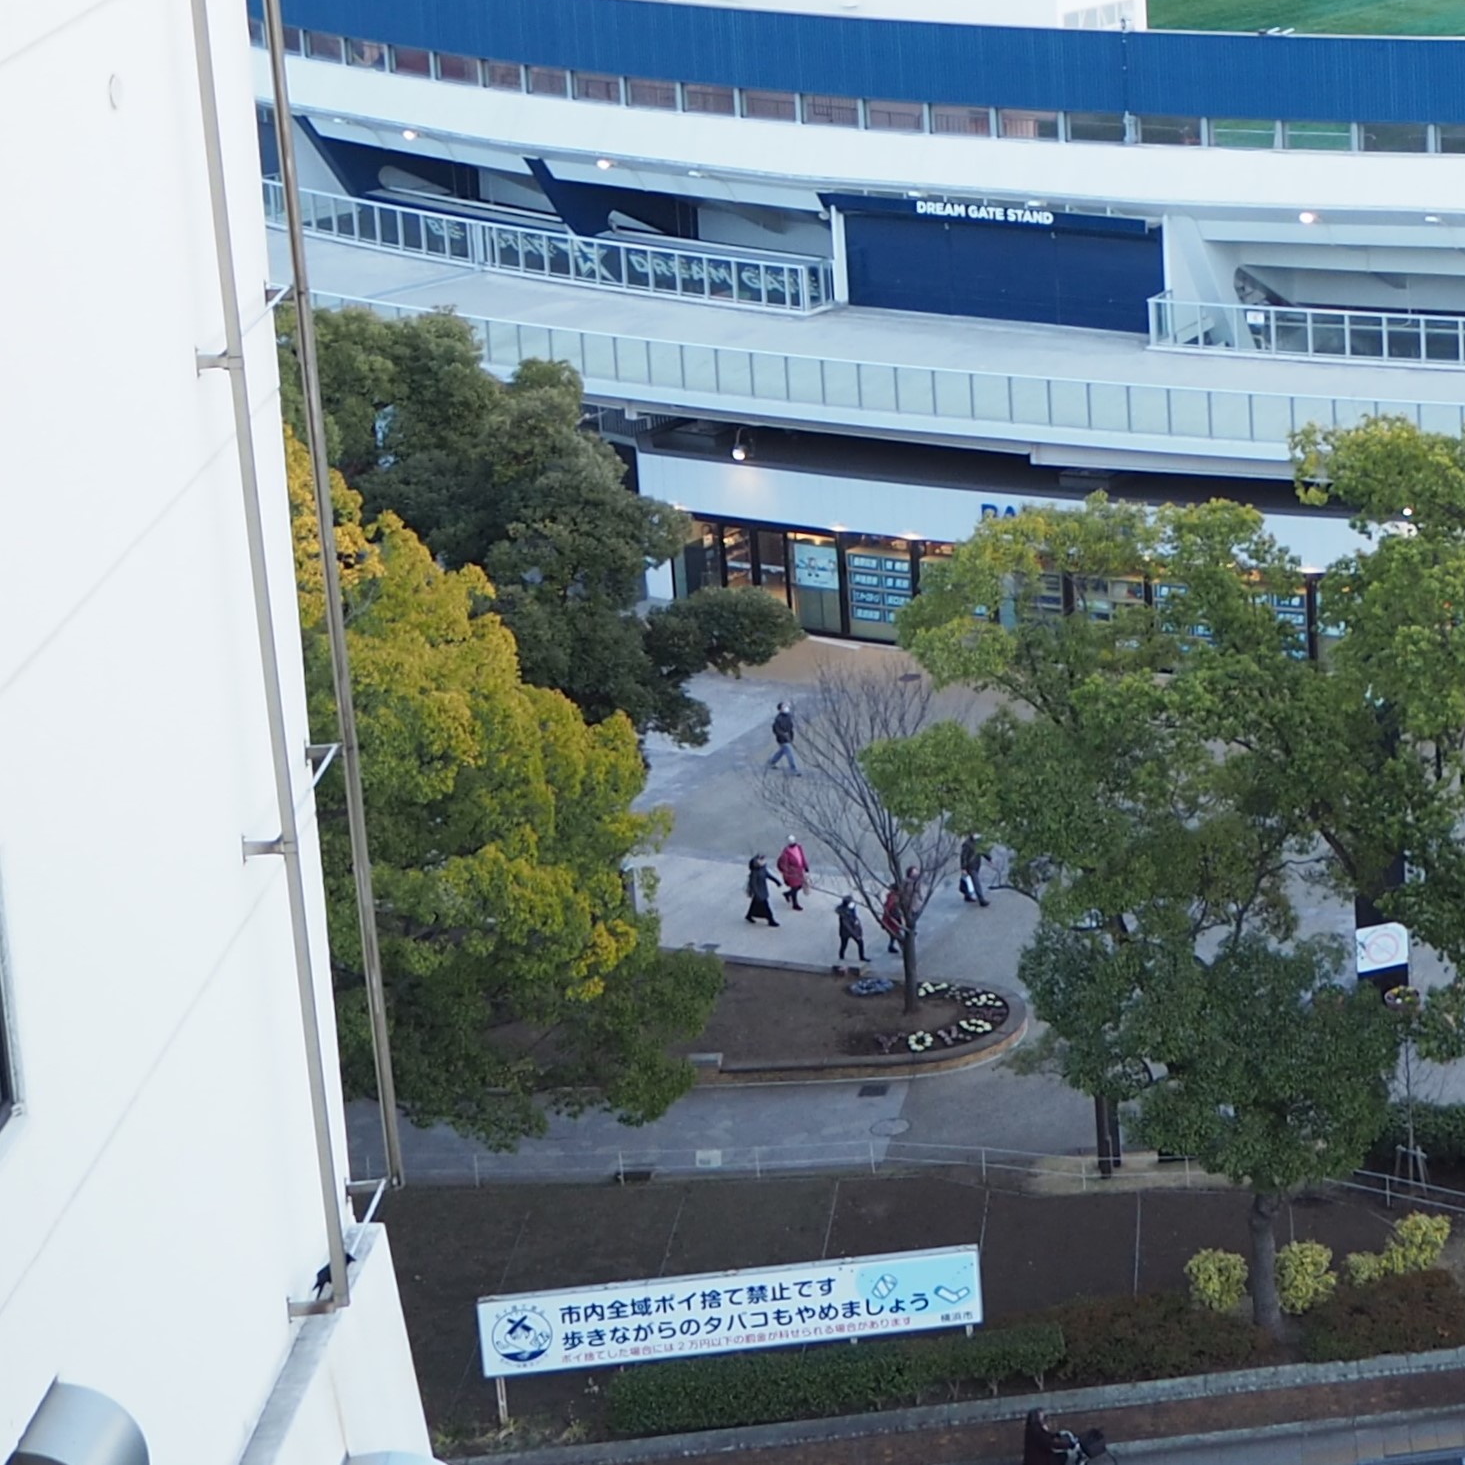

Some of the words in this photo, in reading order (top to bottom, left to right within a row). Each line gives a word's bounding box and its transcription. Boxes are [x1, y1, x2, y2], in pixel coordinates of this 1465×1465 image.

[916, 200, 966, 218] DREAM
[967, 204, 1005, 221] GATE
[1006, 208, 1054, 225] STAND
[559, 1277, 836, 1325] 市内全域ポイ捨て禁止です
[939, 1310, 974, 1323] 横浜市
[562, 1292, 930, 1351] 歩きながらのタバコもやめましょう
